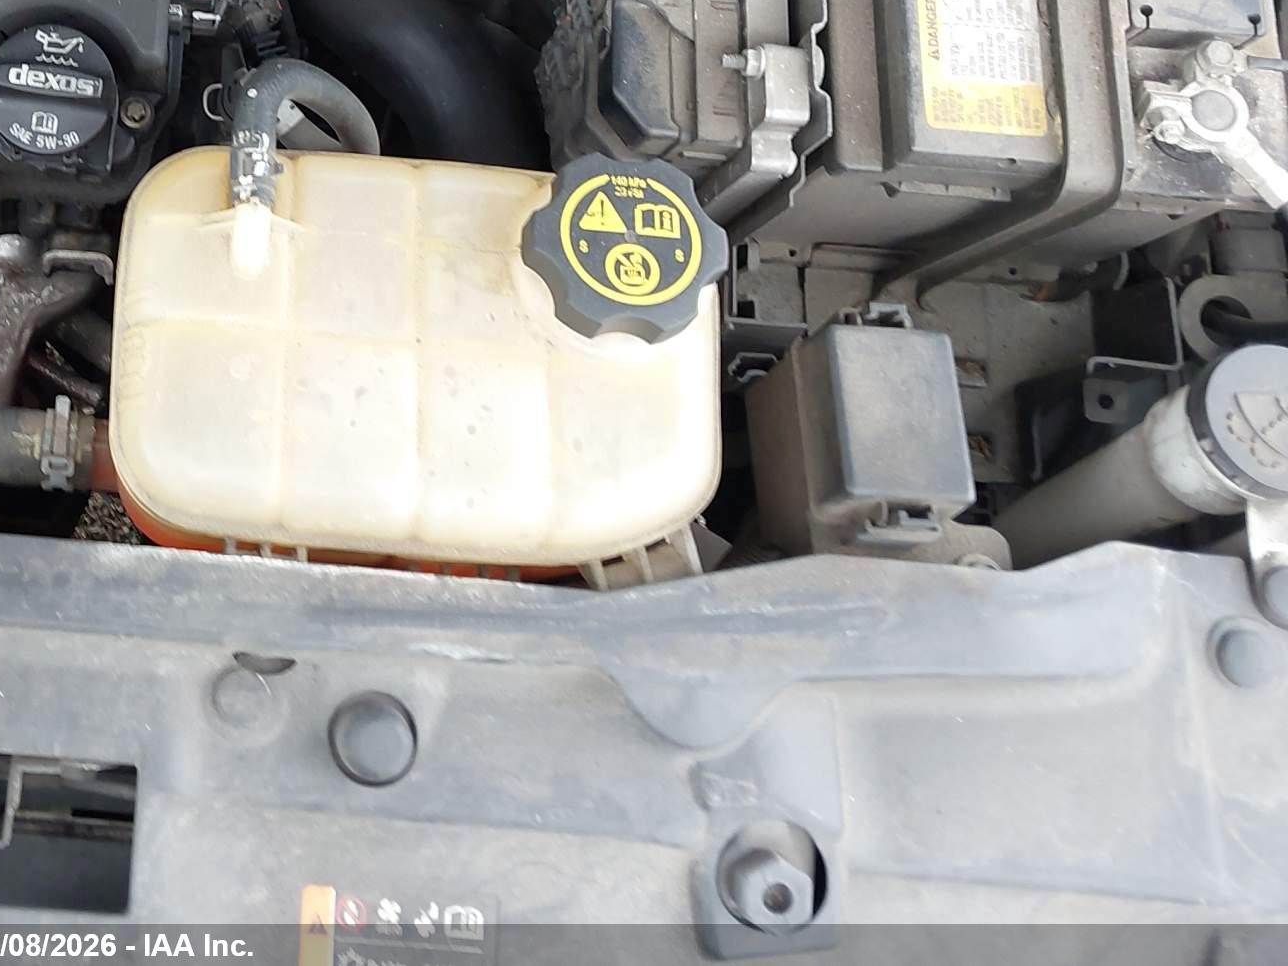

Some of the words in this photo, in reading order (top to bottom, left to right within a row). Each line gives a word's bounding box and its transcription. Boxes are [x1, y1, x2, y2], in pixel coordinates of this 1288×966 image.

[8, 63, 94, 97] dexos
[9, 122, 33, 145] SAE
[35, 131, 80, 150] 5W-30
